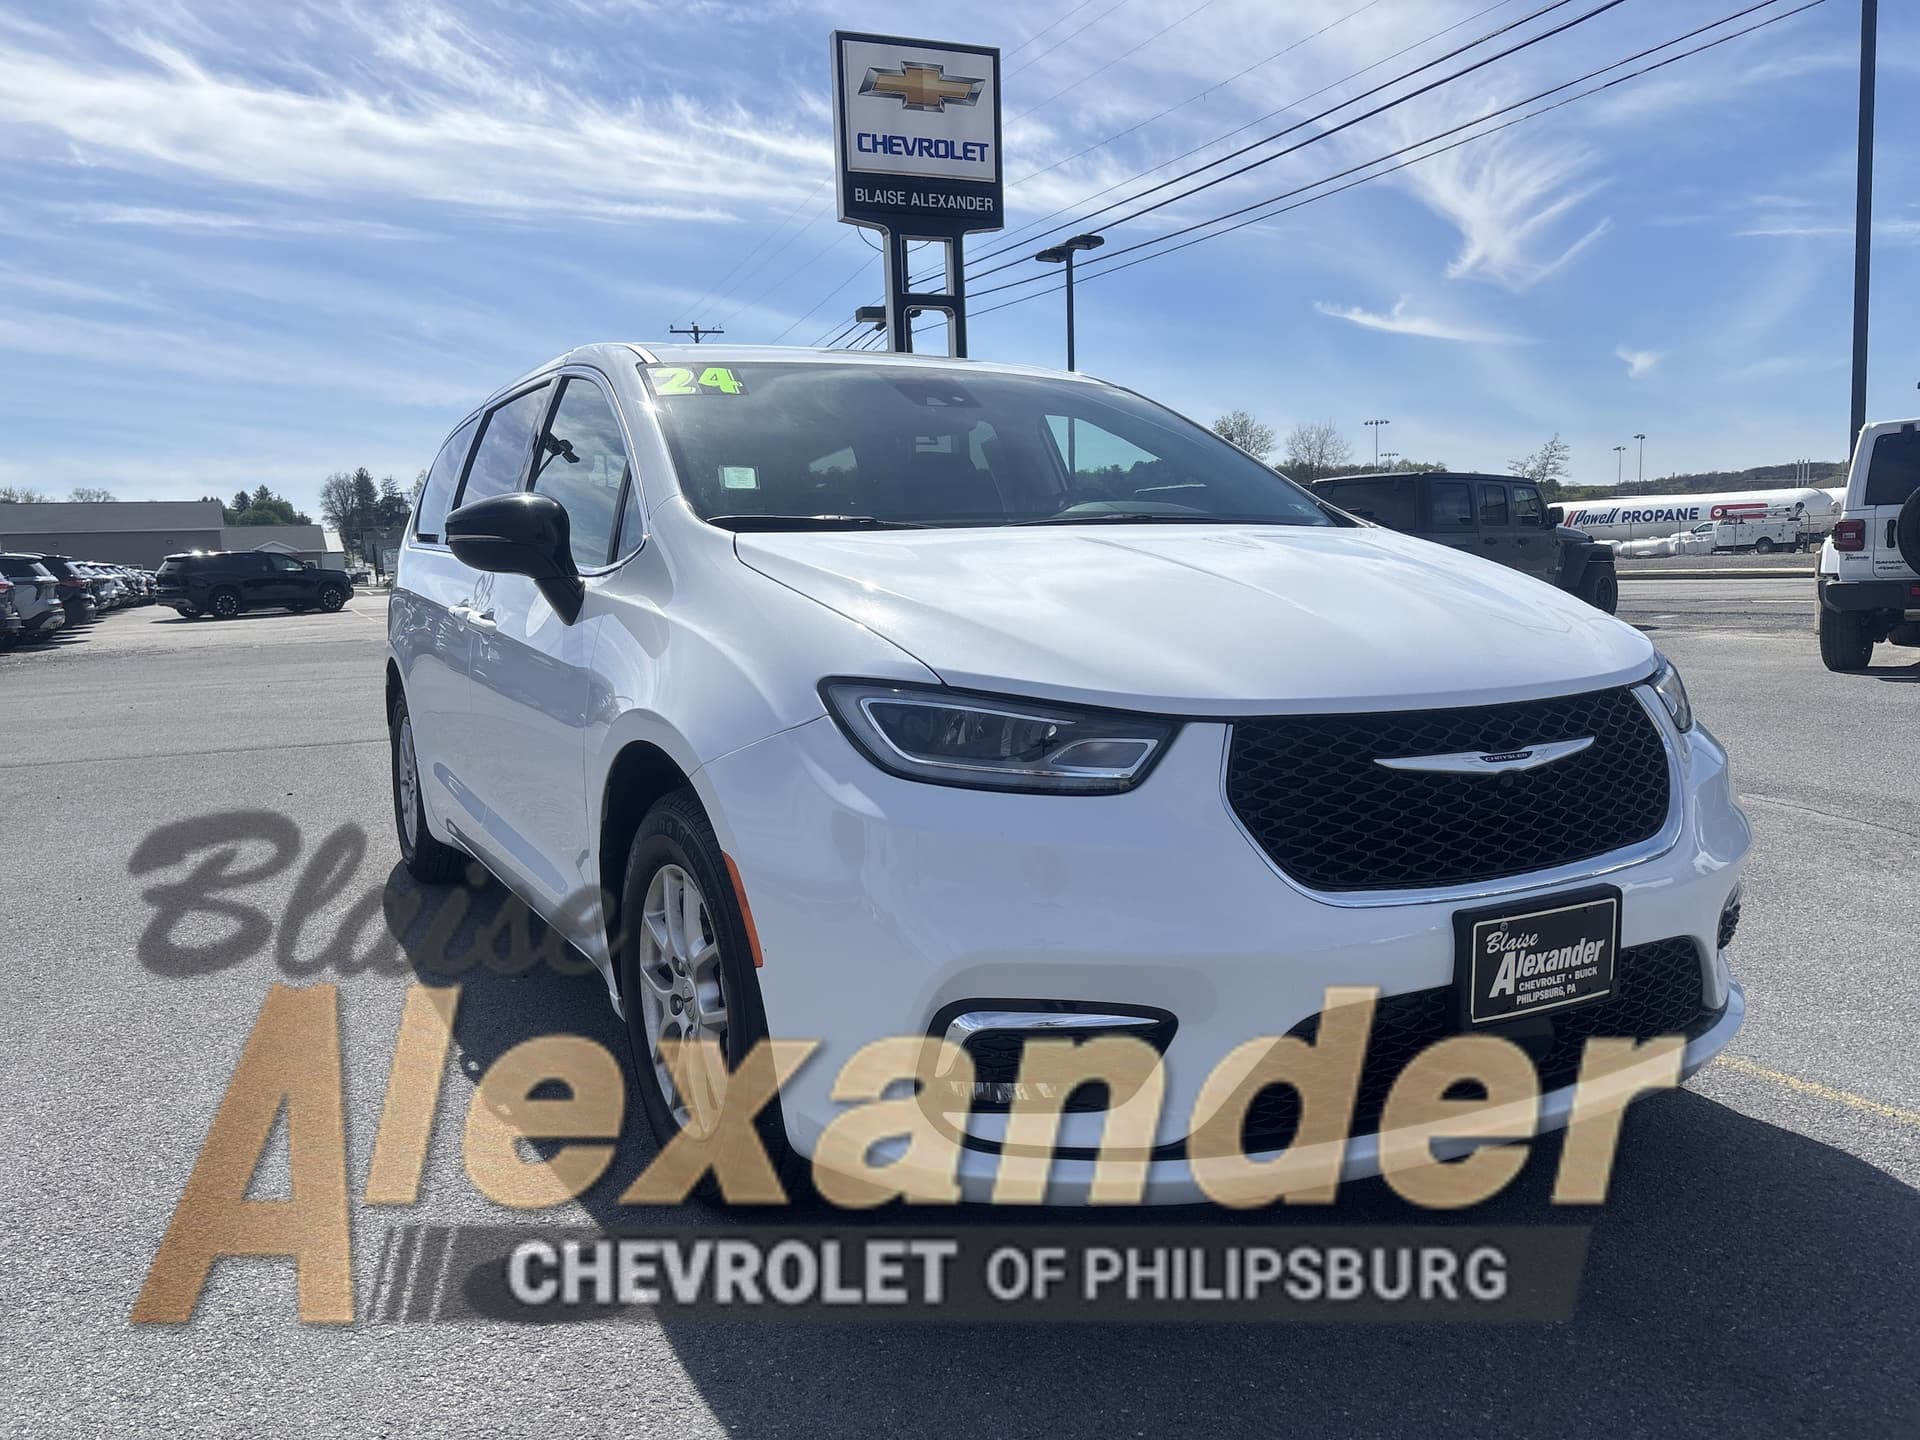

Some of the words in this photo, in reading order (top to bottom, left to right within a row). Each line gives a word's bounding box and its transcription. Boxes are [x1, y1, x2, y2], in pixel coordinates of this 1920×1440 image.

[857, 133, 989, 162] CHEVROLET
[854, 188, 906, 205] BLAISE
[911, 193, 994, 211] ALEXANDER
[653, 367, 744, 395] 24
[1573, 507, 1621, 526] Powell
[1621, 507, 1700, 523] PROPANE
[1485, 753, 1529, 761] CHRYSLER
[1486, 931, 1539, 954] Blaise
[1488, 937, 1606, 999] Alexander
[1518, 974, 1566, 992] CHEVROLET
[1574, 966, 1598, 980] BUICK
[1516, 986, 1566, 1005] PHILIPSBURG,
[1566, 983, 1577, 994] PA
